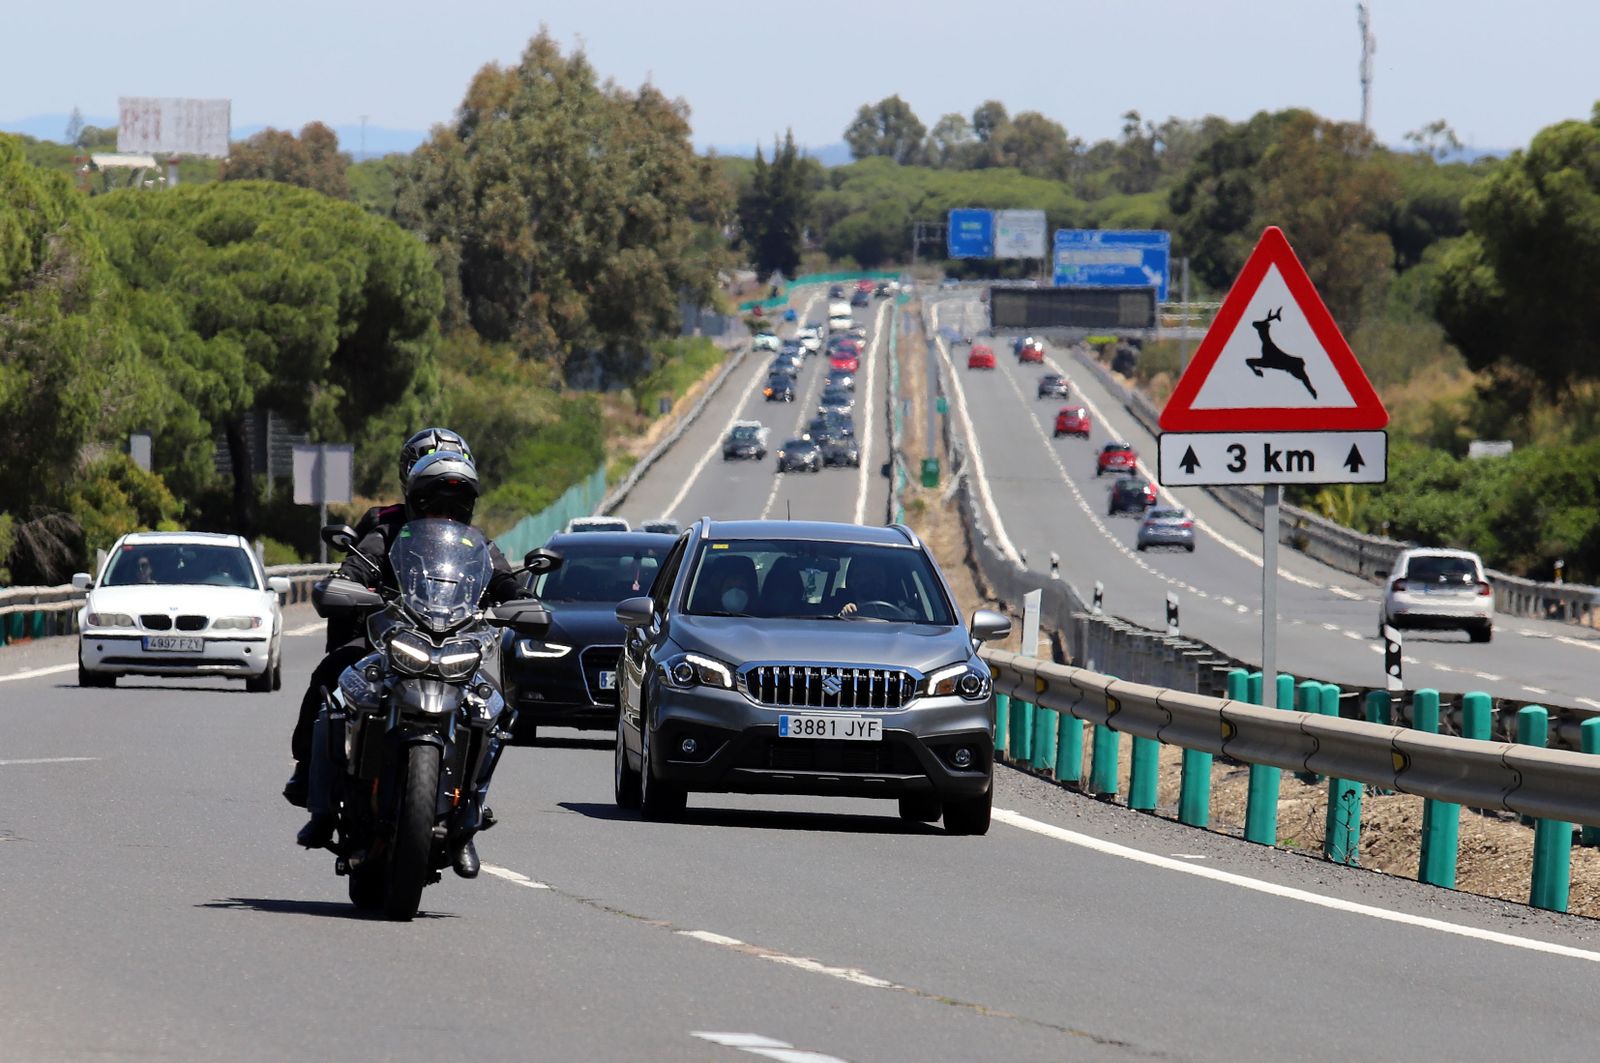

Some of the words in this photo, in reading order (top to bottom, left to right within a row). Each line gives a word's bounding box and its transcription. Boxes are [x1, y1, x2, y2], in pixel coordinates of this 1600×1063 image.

[1226, 443, 1247, 473] 3
[1264, 443, 1315, 473] km
[180, 639, 200, 649] FZY
[792, 719, 836, 736] 3881
[844, 721, 878, 737] JYF
